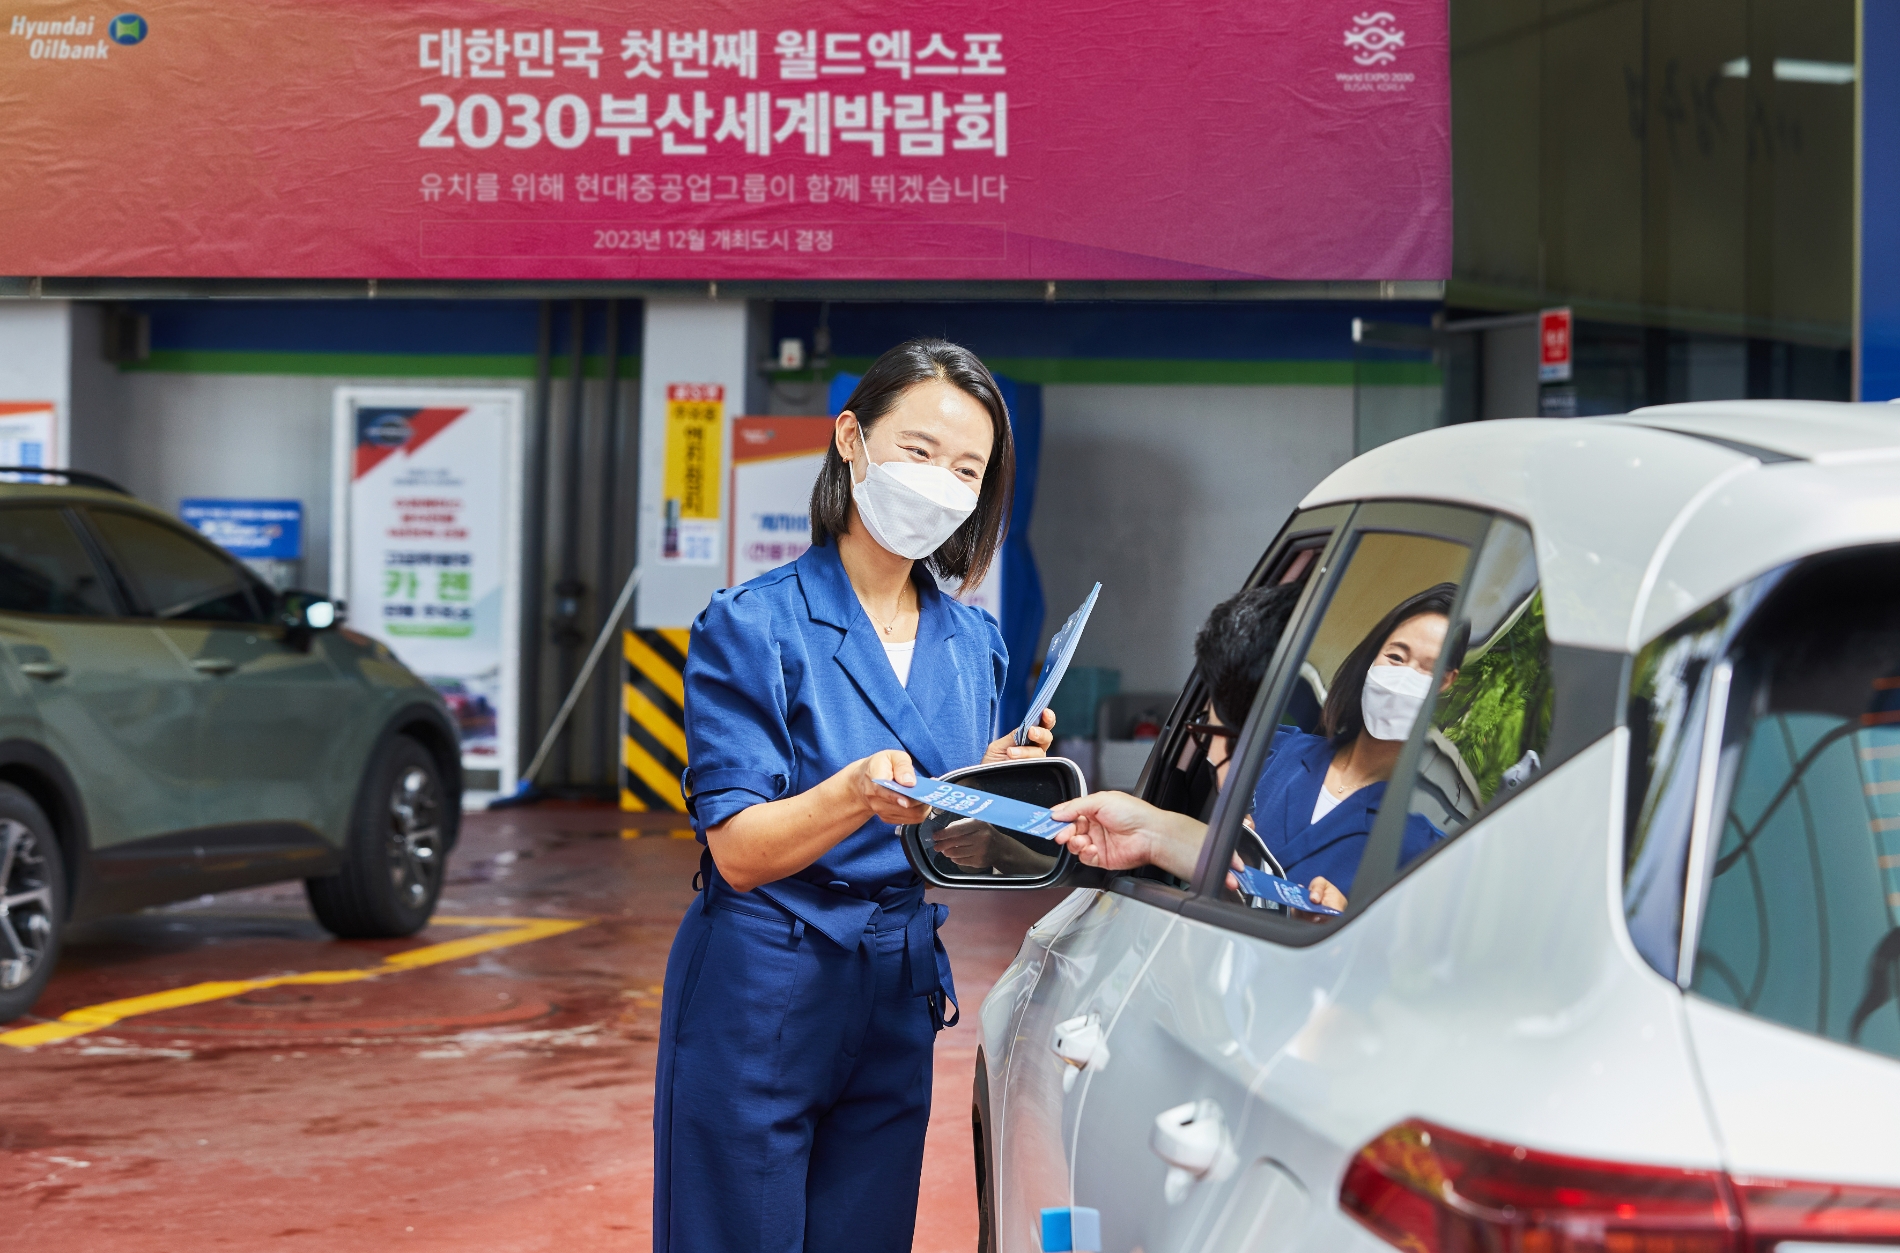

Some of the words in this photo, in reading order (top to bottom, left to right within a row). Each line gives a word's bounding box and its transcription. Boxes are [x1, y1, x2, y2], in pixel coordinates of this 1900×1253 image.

[9, 15, 95, 40] Hyundai
[29, 38, 109, 59] Oilbank
[418, 28, 604, 79] 대한민국
[620, 28, 758, 79] 첫번째
[773, 29, 1006, 79] 월드엑스포
[418, 91, 1008, 157] 2030부산세계박람회
[418, 172, 501, 202] 유치를
[511, 172, 564, 202] 위해
[574, 172, 795, 203] 현대중공업그룹이
[805, 174, 860, 203] 함께
[869, 174, 1009, 204] 뛰겠습니다
[593, 229, 661, 251] 2023년
[667, 229, 705, 251] 12월
[711, 229, 789, 251] 개최도시
[795, 229, 833, 251] 결정
